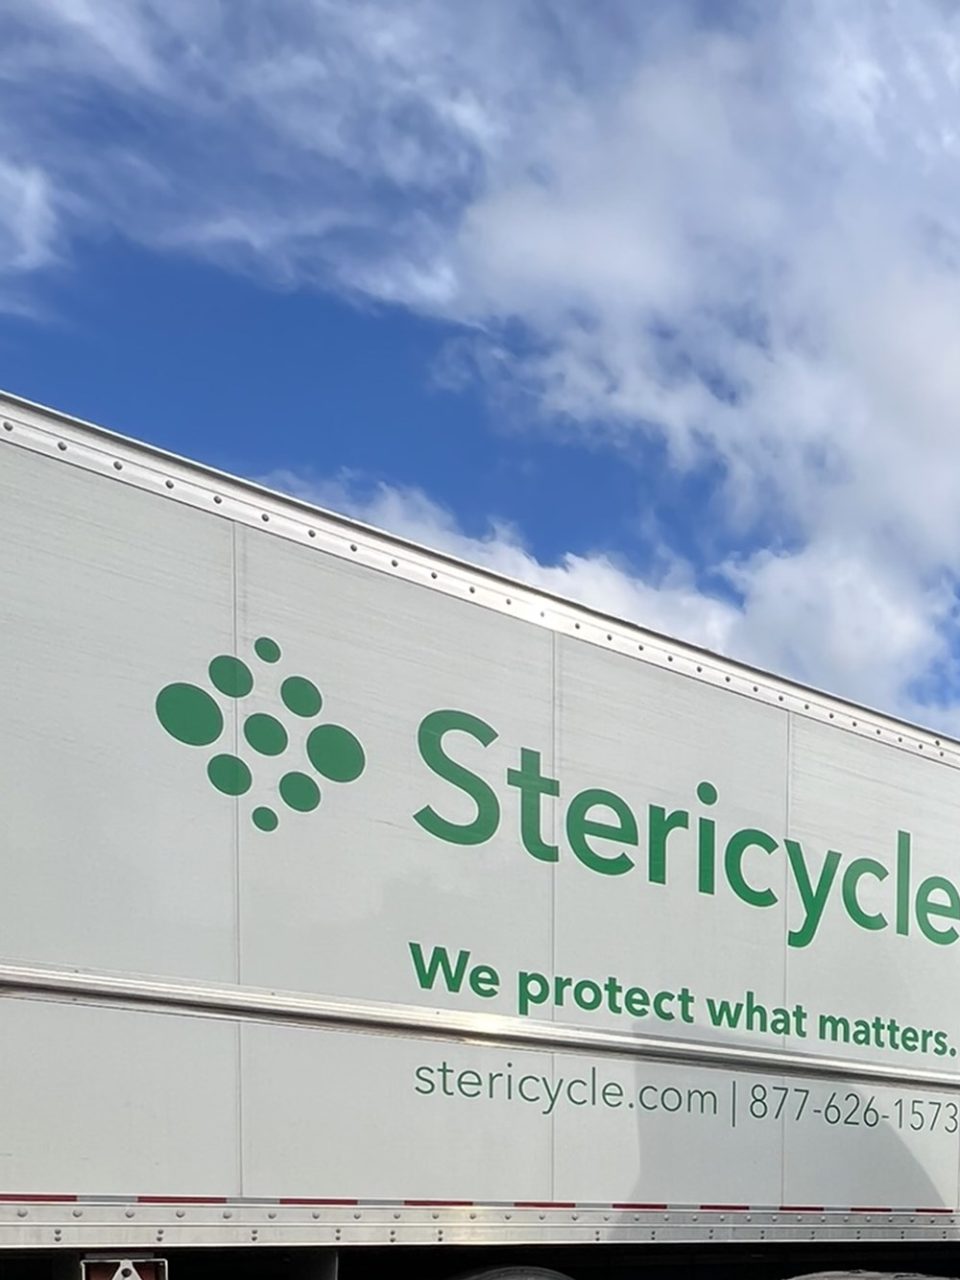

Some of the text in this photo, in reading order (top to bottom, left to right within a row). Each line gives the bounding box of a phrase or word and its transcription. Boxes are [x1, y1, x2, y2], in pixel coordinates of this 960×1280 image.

[409, 942, 958, 1058] We protect what matters.
[414, 1061, 959, 1134] stericycle.com 877-626-1573
